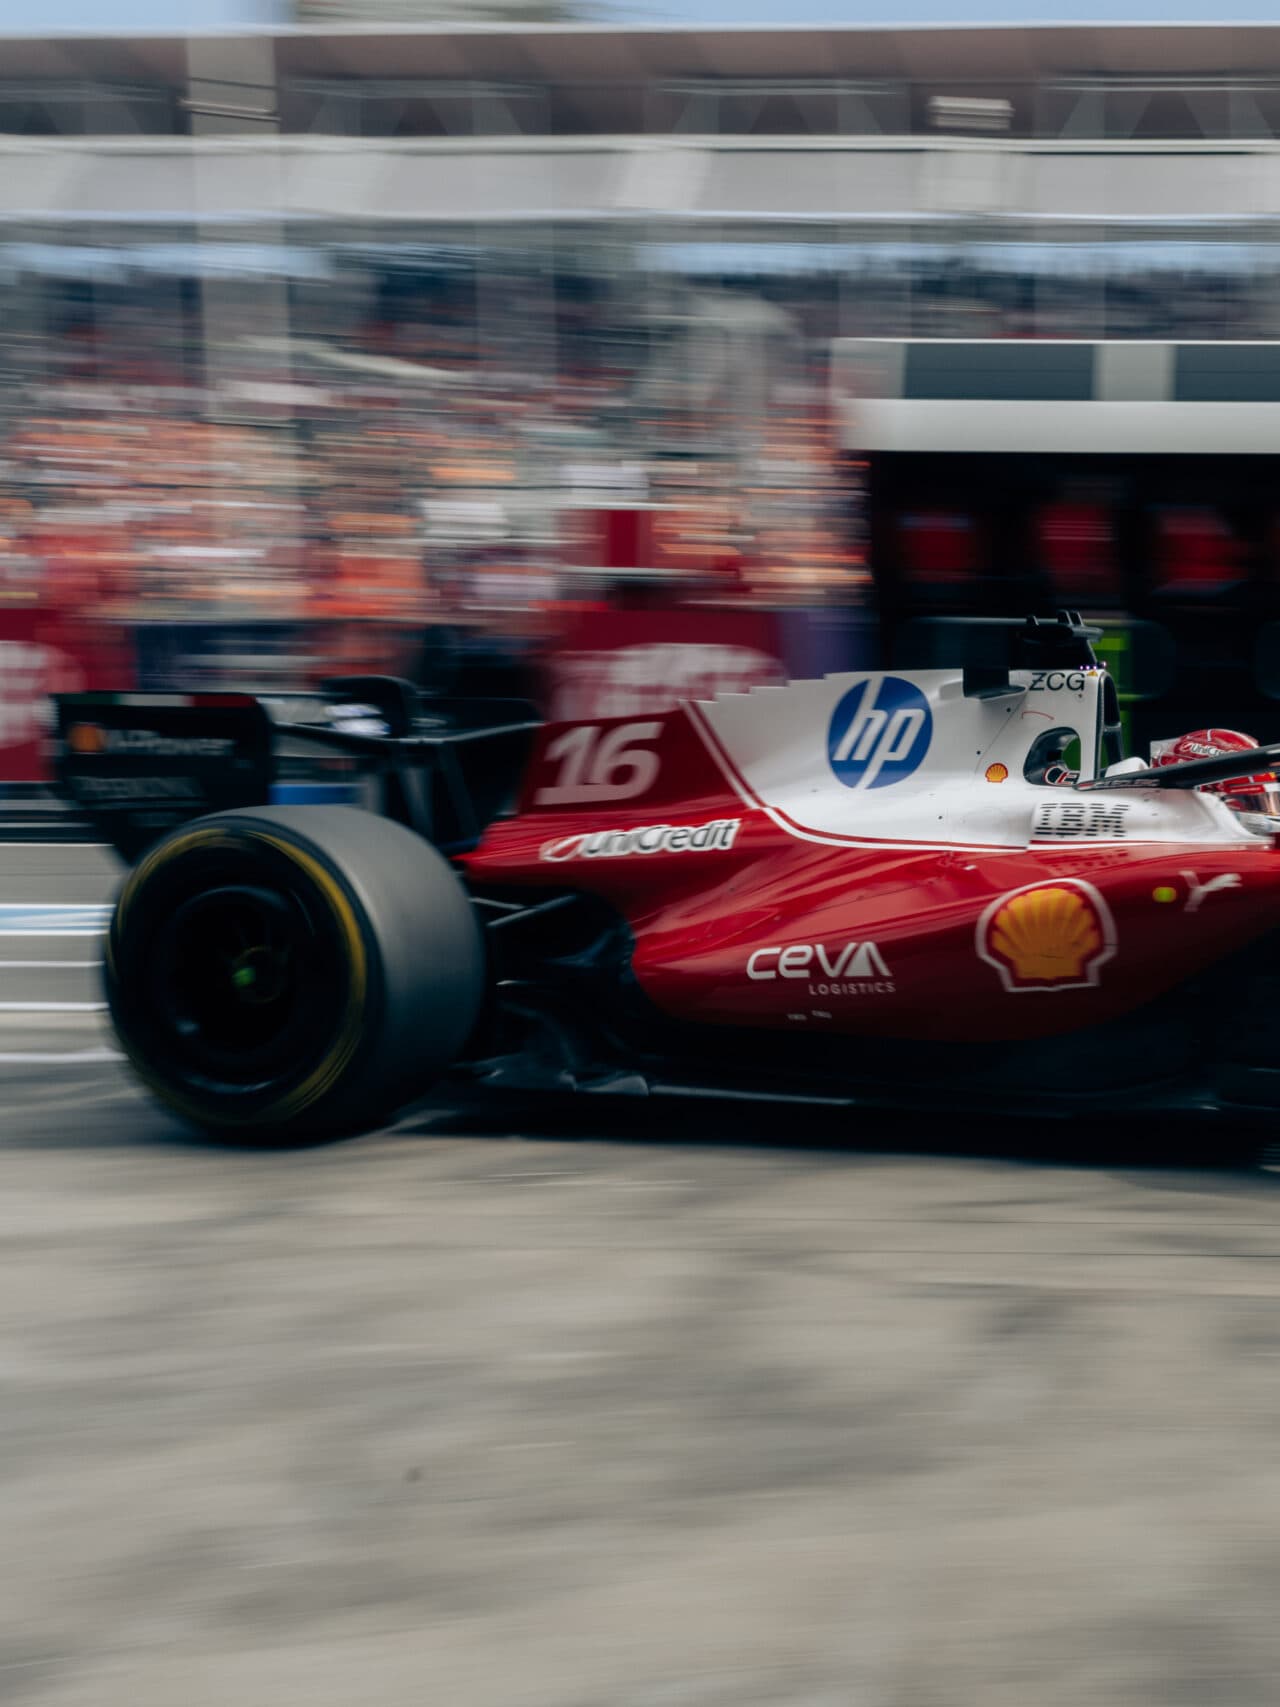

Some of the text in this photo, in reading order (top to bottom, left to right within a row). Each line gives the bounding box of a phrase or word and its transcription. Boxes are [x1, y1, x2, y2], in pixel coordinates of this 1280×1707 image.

[1029, 672, 1085, 691] ZCG
[832, 679, 926, 789] hp
[534, 721, 665, 805] 16
[582, 818, 740, 854] UniCredit
[1033, 803, 1130, 837] IBM
[808, 982, 896, 995] LOGISTICS
